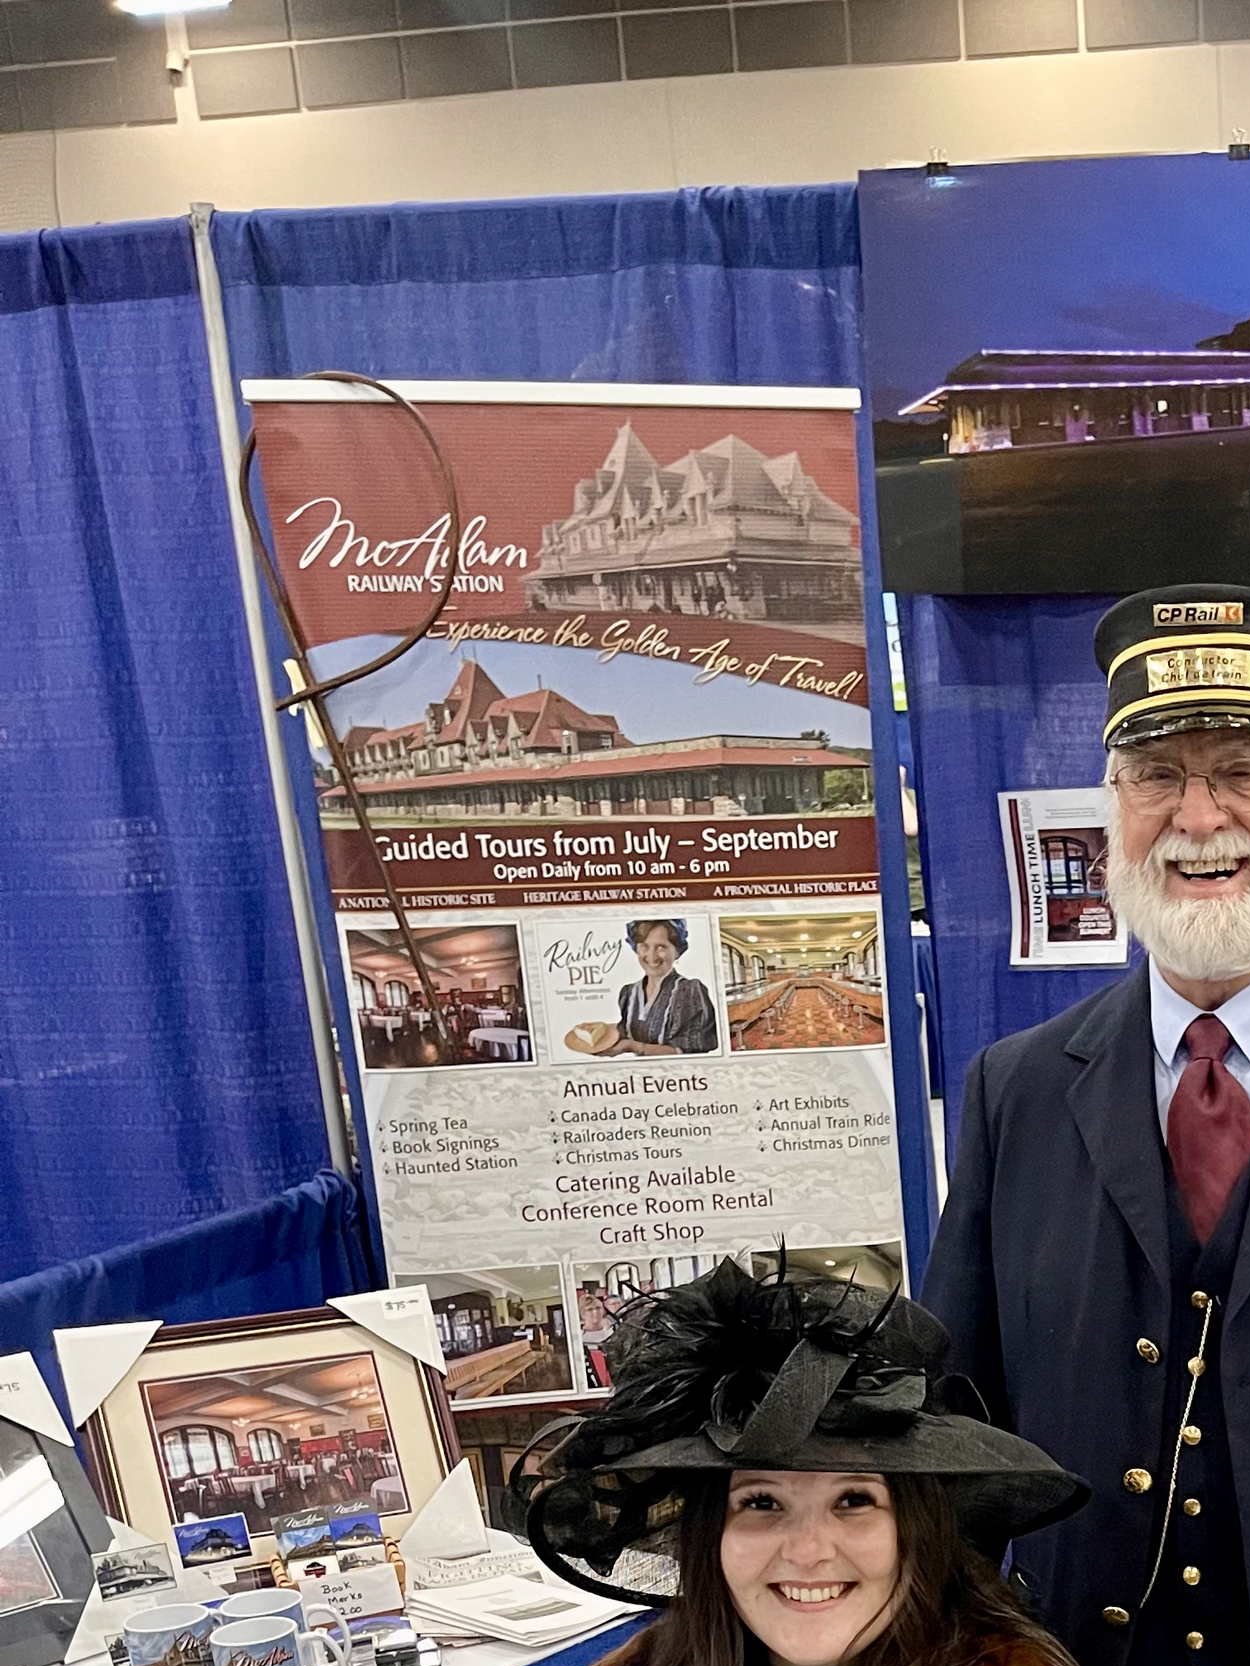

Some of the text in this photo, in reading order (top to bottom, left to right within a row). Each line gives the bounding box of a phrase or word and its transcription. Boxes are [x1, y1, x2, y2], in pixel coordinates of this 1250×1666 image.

[348, 575, 424, 593] RAILWAY
[1157, 606, 1219, 622] CP Rail
[426, 606, 864, 700] Experience the Golden Age of Travel!
[474, 834, 547, 858] Tours
[553, 830, 616, 857] from
[622, 827, 671, 860] July
[702, 824, 839, 858] September
[1024, 834, 1036, 869] TIME
[493, 858, 730, 883] Open Daily from 10 am 6 pm
[523, 886, 687, 904] HERITAGE RAILWAY STATION
[713, 880, 877, 897] A PROVINCIAL HISTORIC PLACE
[1029, 873, 1044, 924] LUNCH
[412, 893, 468, 907] HISTORIC
[470, 892, 495, 905] SITE
[543, 931, 622, 974] Railway
[568, 966, 604, 985] PIE
[563, 1073, 709, 1098] Annual Events
[561, 1101, 739, 1123] Canada Day Celebration
[769, 1095, 850, 1111] Art Exhibits
[389, 1117, 468, 1137] Spring Tea
[770, 1112, 891, 1132] Annual Train Ride
[563, 1124, 712, 1144] Railroaders Reunion
[773, 1133, 891, 1152] Christmas Dinner
[392, 1136, 500, 1155] Book Signings
[566, 1146, 682, 1165] Christmas Tours
[396, 1155, 518, 1176] Haunted Station
[555, 1165, 736, 1194] Catering Available
[521, 1189, 774, 1222] Conference Room Rental
[600, 1222, 705, 1245] Craft Shop
